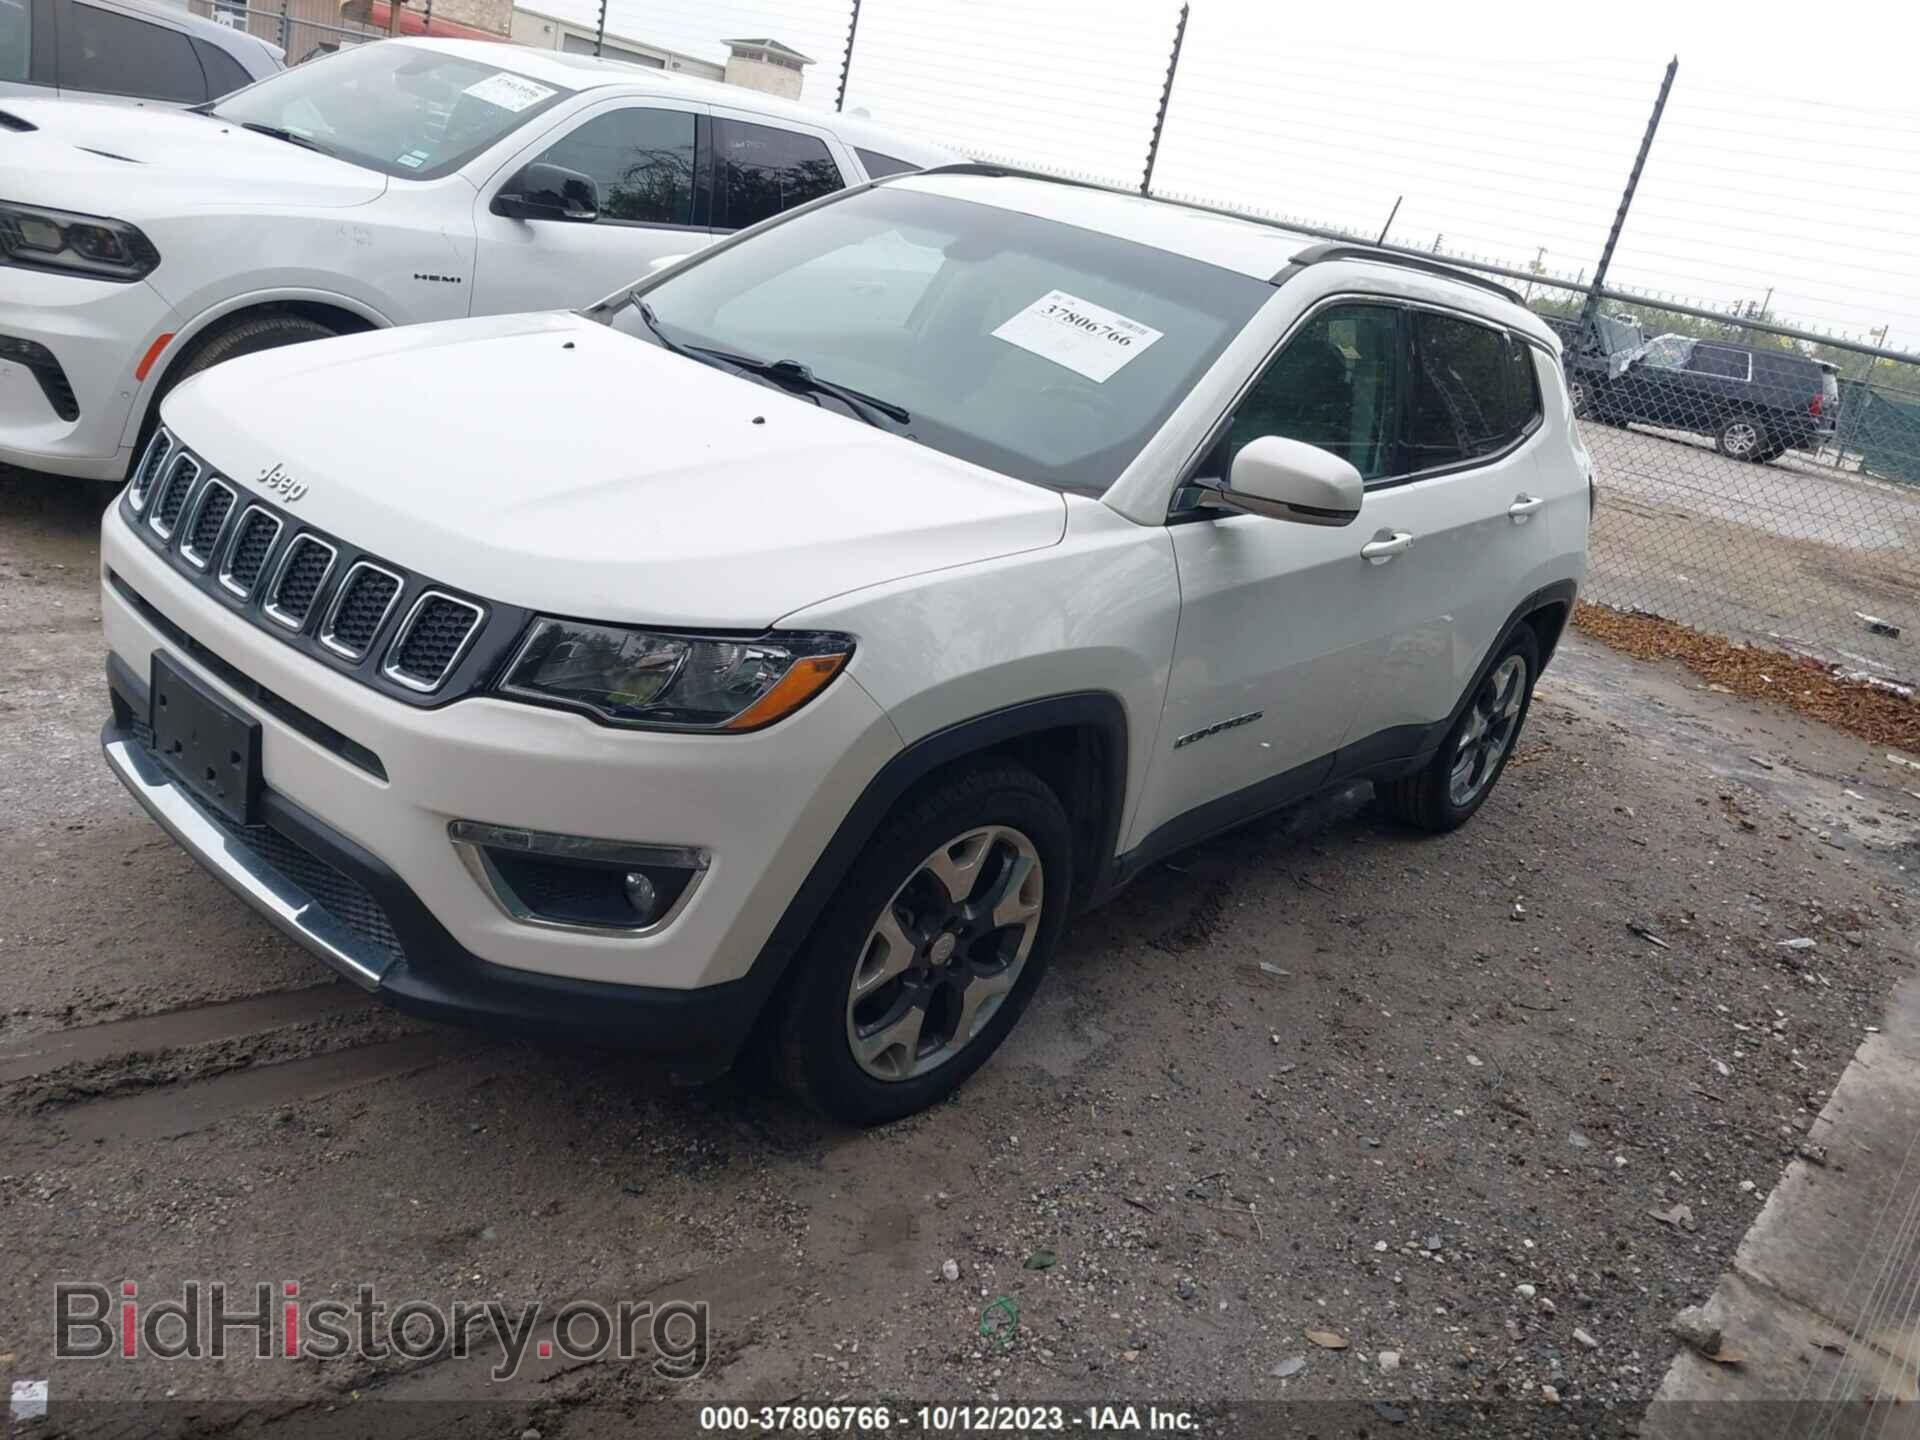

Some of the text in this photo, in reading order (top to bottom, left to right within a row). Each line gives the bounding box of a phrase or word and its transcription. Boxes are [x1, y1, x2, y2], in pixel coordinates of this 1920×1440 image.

[414, 273, 461, 283] HEMI
[1041, 304, 1132, 347] 37806766
[256, 463, 309, 503] Jeep
